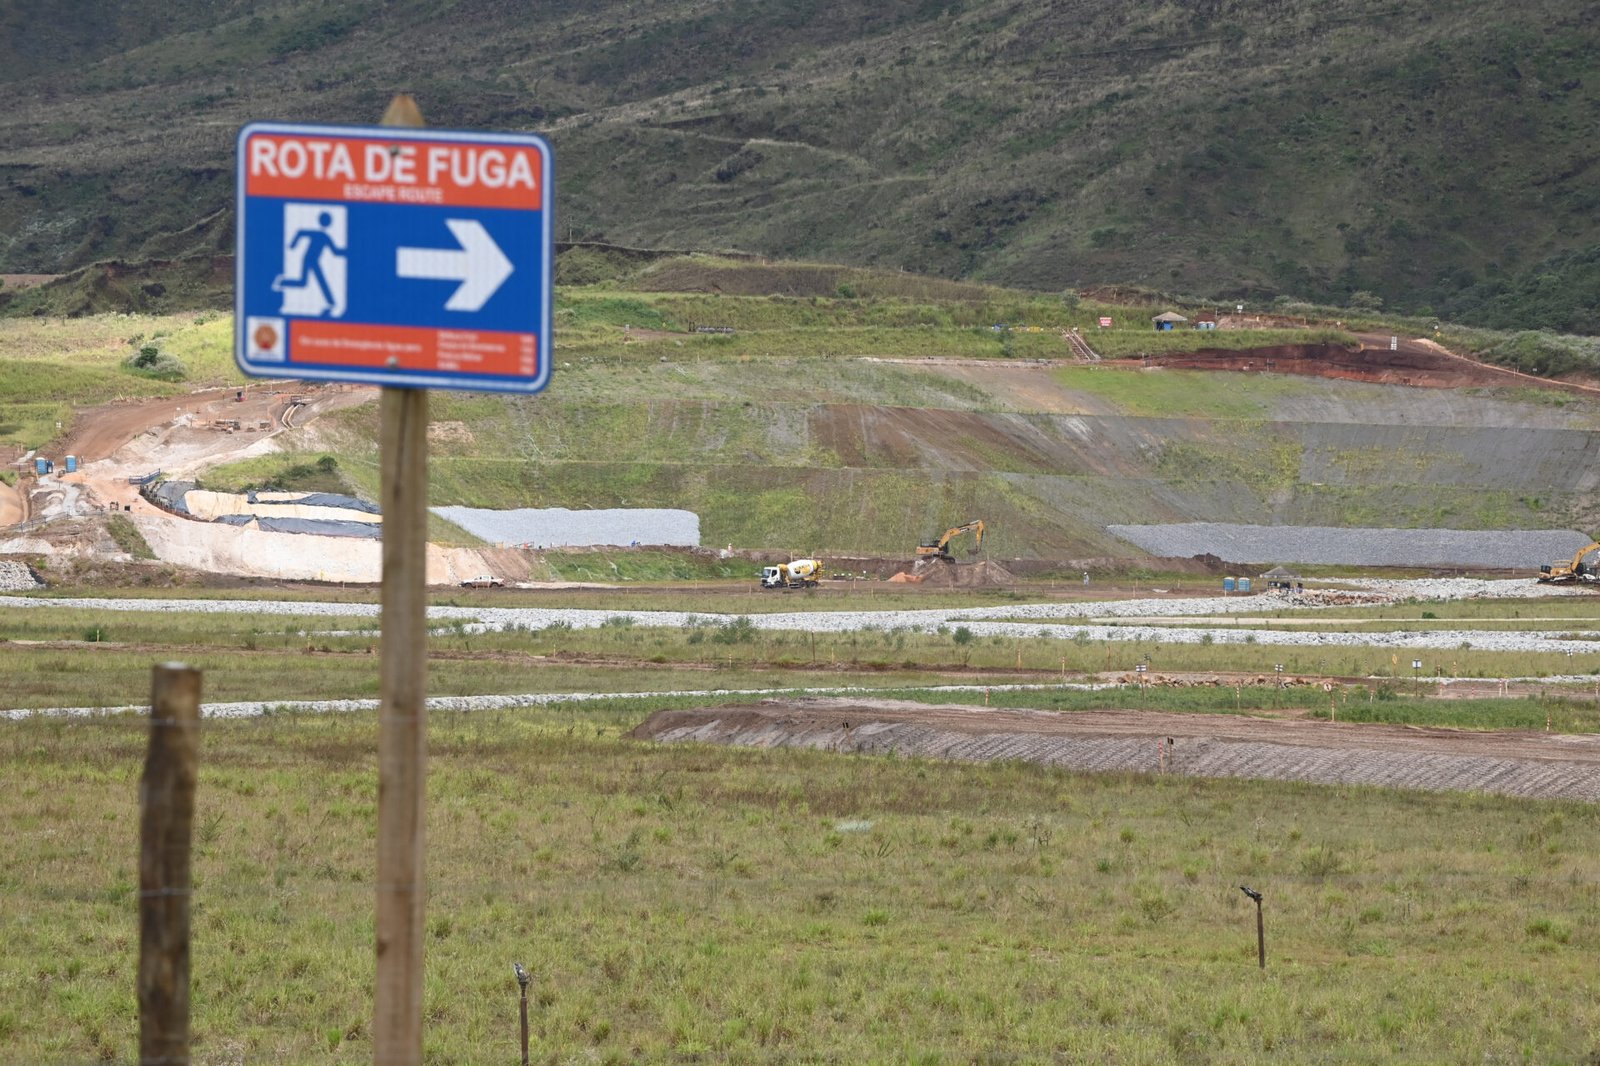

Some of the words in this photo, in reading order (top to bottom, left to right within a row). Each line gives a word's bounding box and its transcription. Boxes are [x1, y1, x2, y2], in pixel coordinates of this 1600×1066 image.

[250, 138, 356, 181] ROTA
[364, 144, 417, 184] DE
[427, 147, 537, 190] FUGA
[343, 182, 396, 202] ESCAPE
[398, 186, 443, 204] ROUTE
